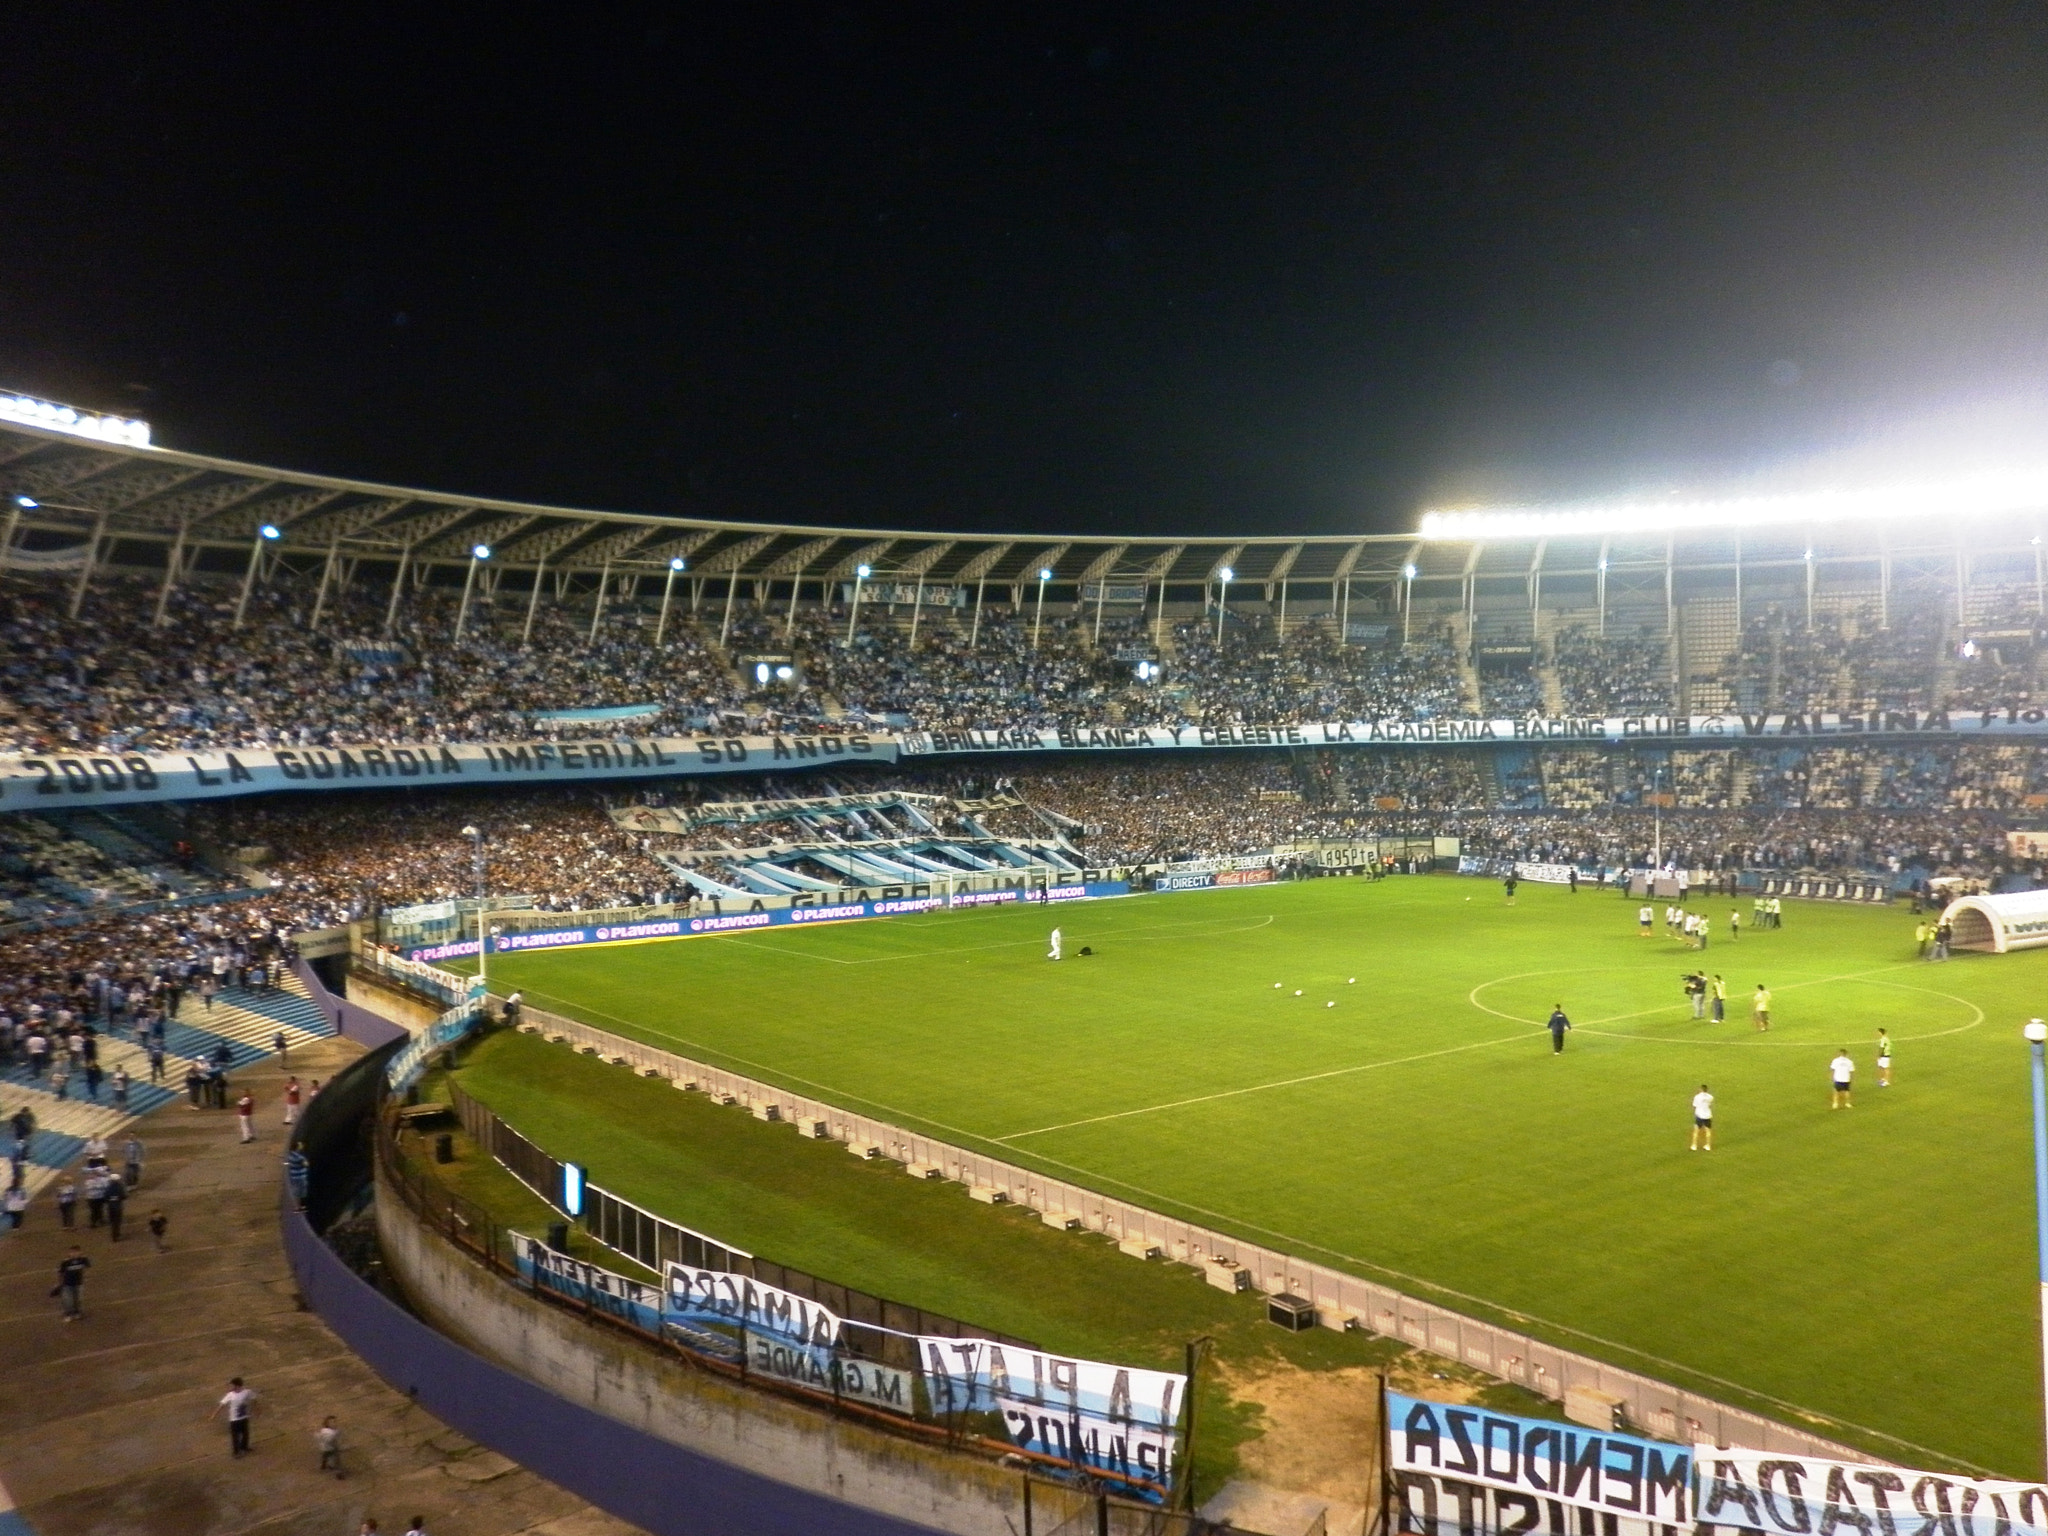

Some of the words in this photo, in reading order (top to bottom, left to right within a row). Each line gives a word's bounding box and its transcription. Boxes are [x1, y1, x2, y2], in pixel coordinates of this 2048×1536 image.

[931, 729, 1046, 752] BRILLARA
[1057, 728, 1155, 749] BLANCA
[1166, 727, 1184, 746] Y
[1322, 724, 1353, 743] LA
[1369, 721, 1498, 742] ACADEMIA
[1513, 718, 1606, 740] RACING
[1622, 717, 1691, 738] CLUB
[22, 757, 159, 795] 2008
[188, 753, 254, 786] LA
[274, 747, 463, 780] GUARDIA
[483, 742, 677, 774] IMPERIAL
[772, 735, 874, 761] AÑOS
[1172, 875, 1211, 889] DIRECTV
